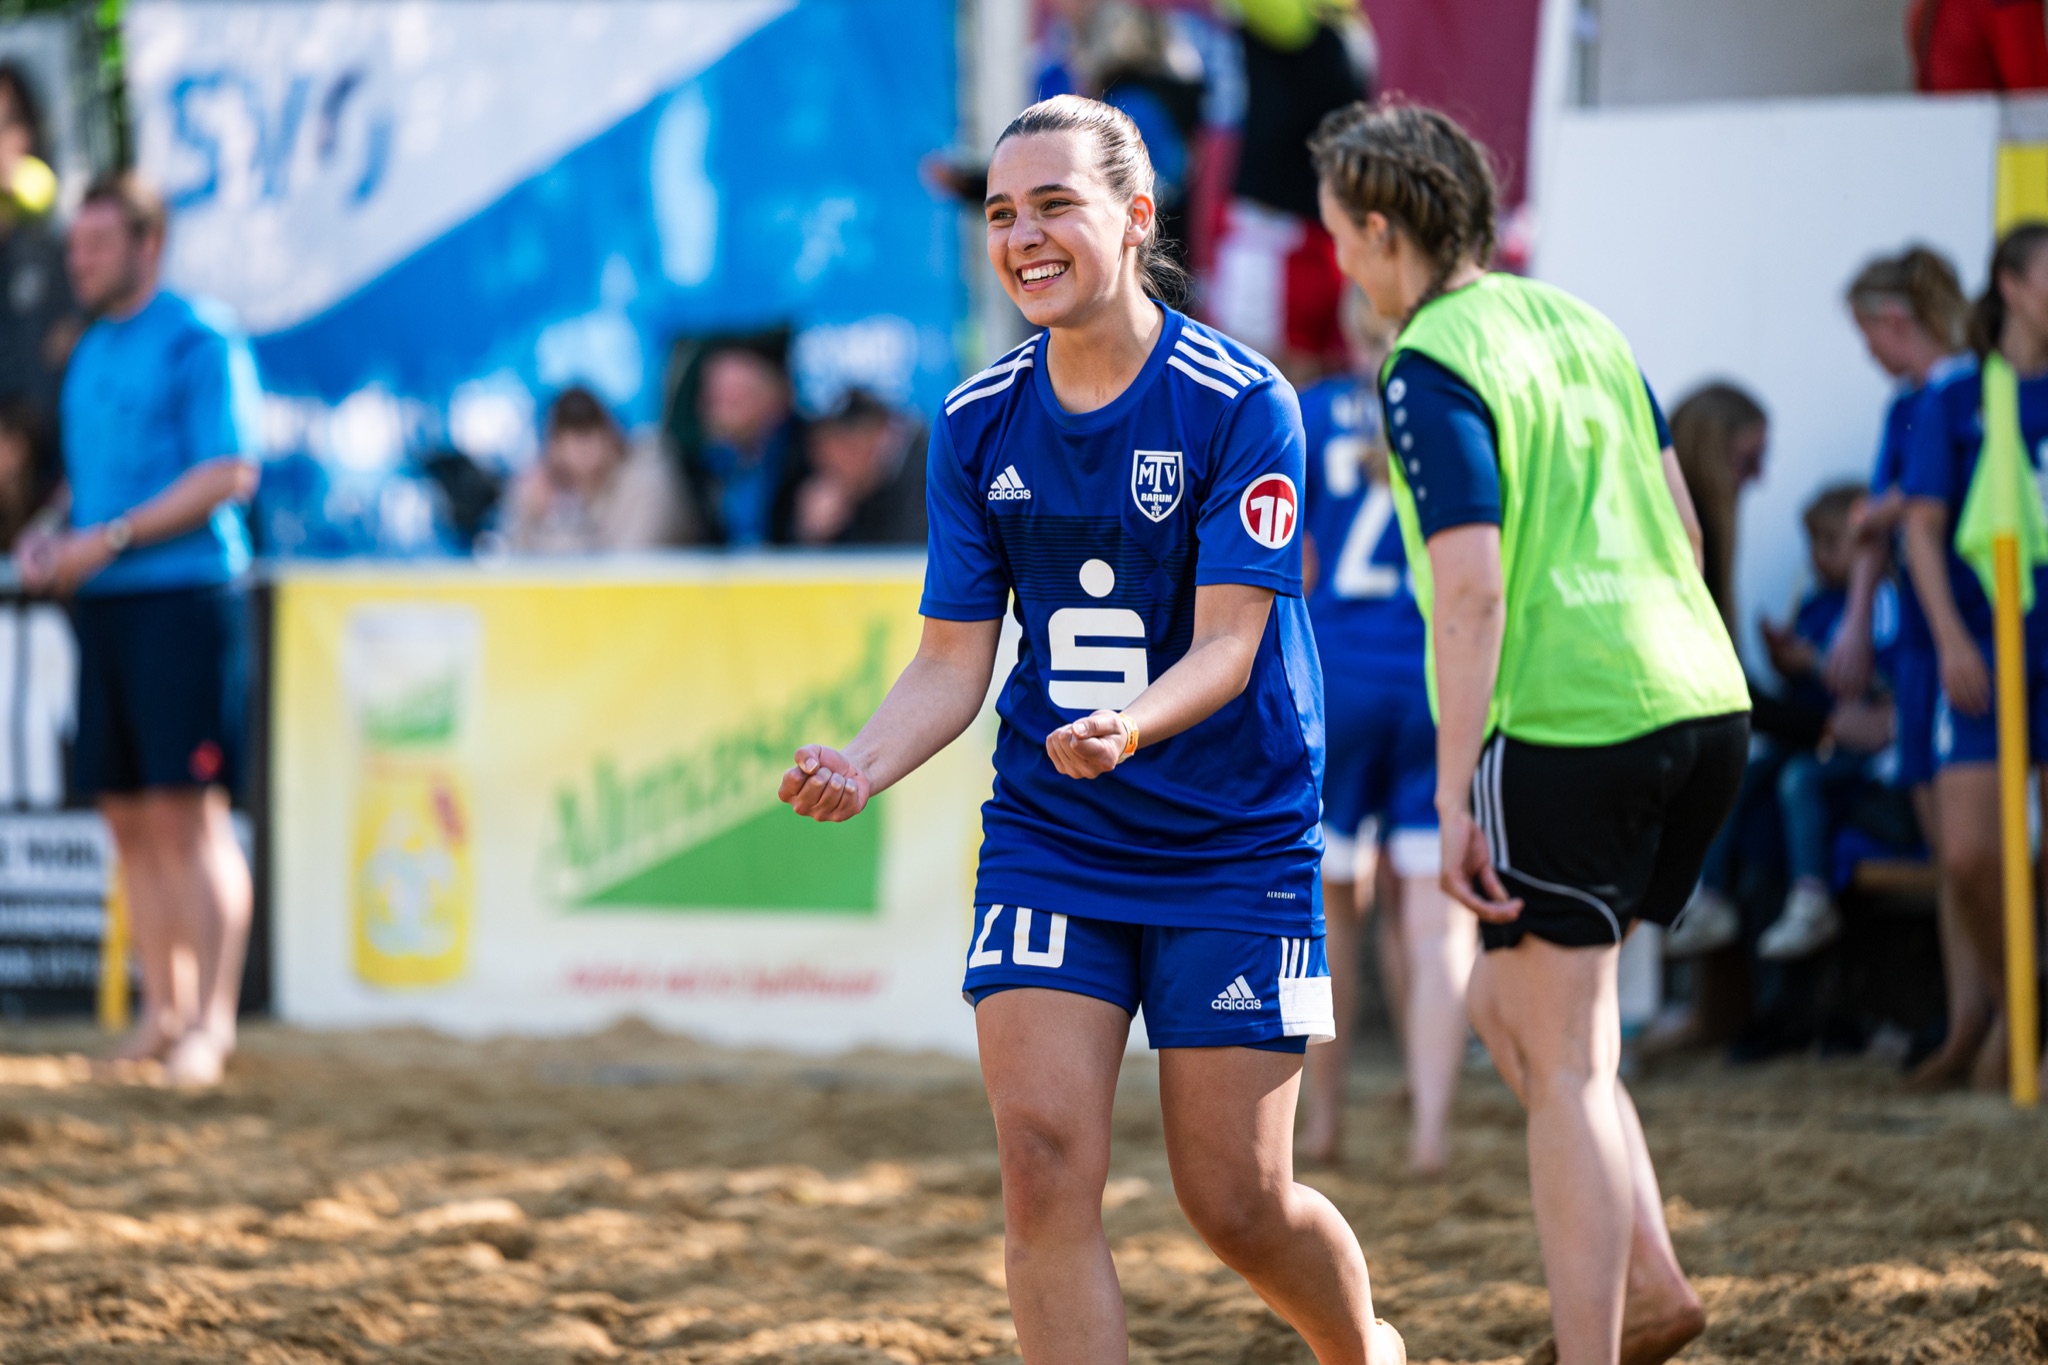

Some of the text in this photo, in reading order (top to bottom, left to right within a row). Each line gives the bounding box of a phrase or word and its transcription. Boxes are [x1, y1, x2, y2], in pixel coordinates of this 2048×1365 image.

[1138, 456, 1177, 493] MTV
[988, 488, 1032, 501] adidas
[1141, 493, 1172, 503] BARUM
[1266, 891, 1296, 900] AEROREADY
[1211, 997, 1262, 1011] adidas
